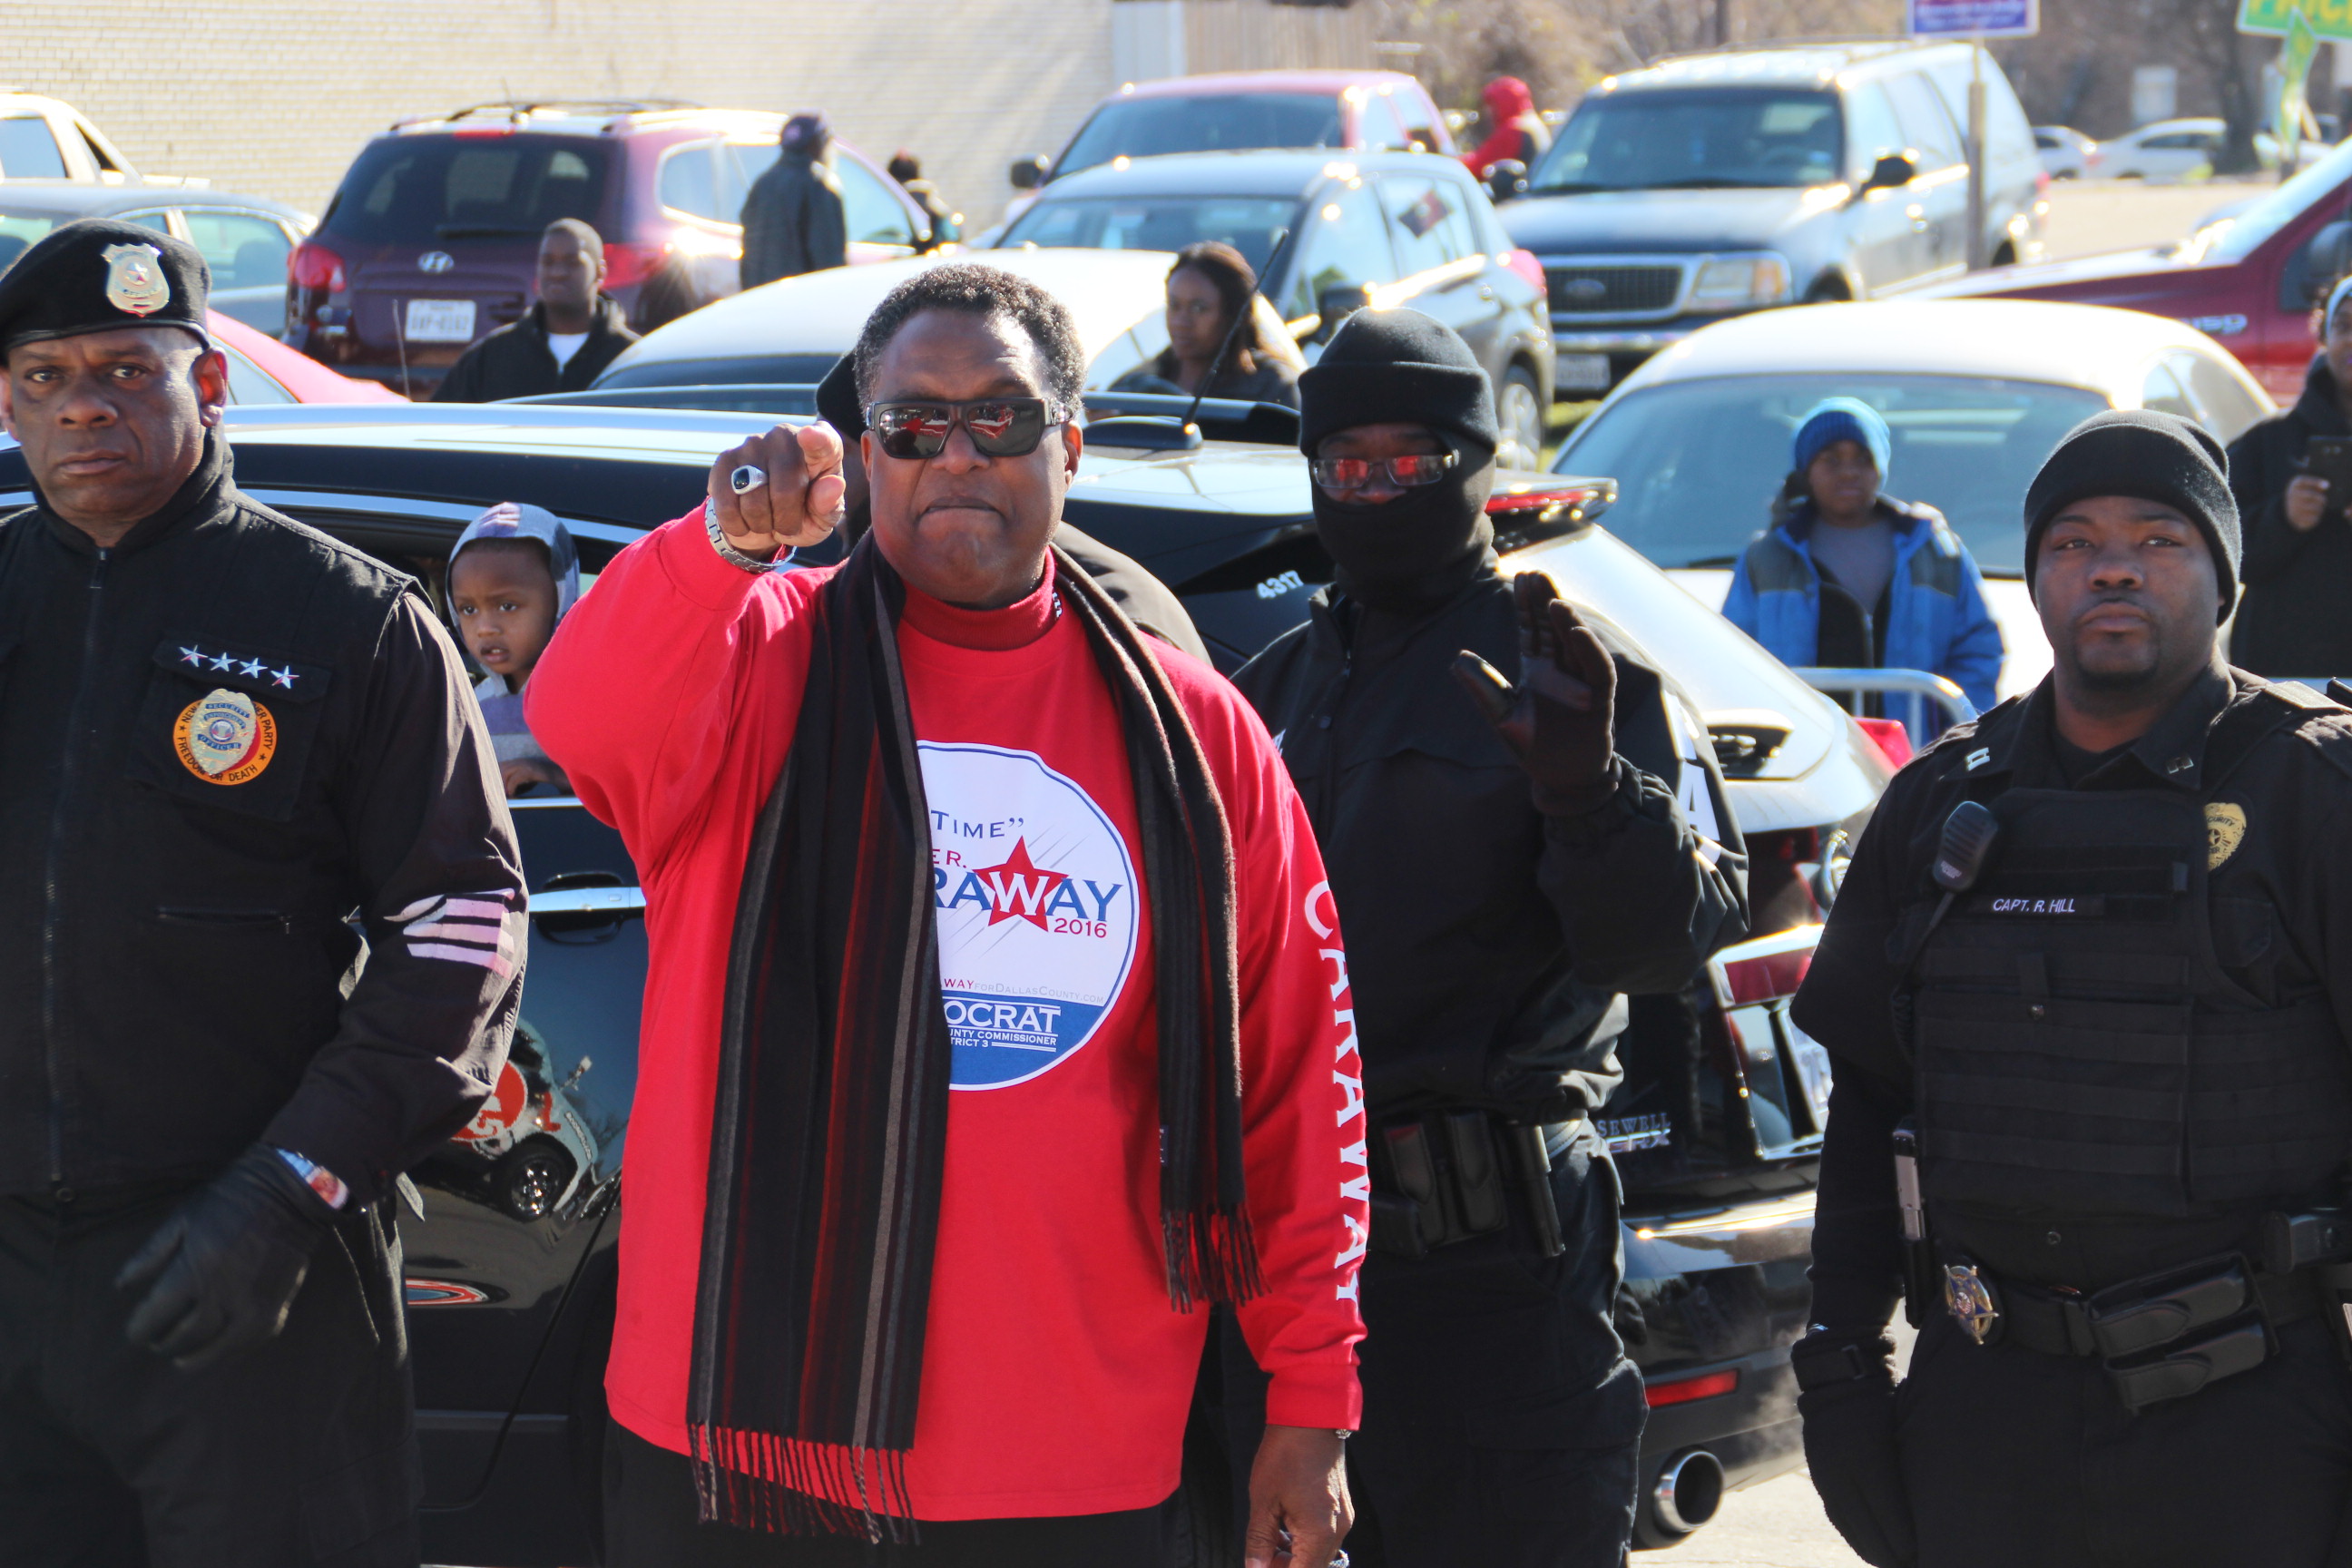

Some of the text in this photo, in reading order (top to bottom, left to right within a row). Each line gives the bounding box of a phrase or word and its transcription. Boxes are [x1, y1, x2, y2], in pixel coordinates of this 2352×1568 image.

[1257, 570, 1304, 599] 4317
[208, 703, 248, 718] SECURITY
[200, 736, 240, 750] OFFICER
[261, 720, 273, 750] PARTY
[229, 764, 258, 782] DEATH
[1993, 898, 2076, 914] CAPT. R. HILL
[1054, 917, 1108, 938] 2016
[977, 1030, 1057, 1046] COMMISSIONER
[981, 1039, 989, 1048] 3
[1597, 1112, 1671, 1138] SEWELL
